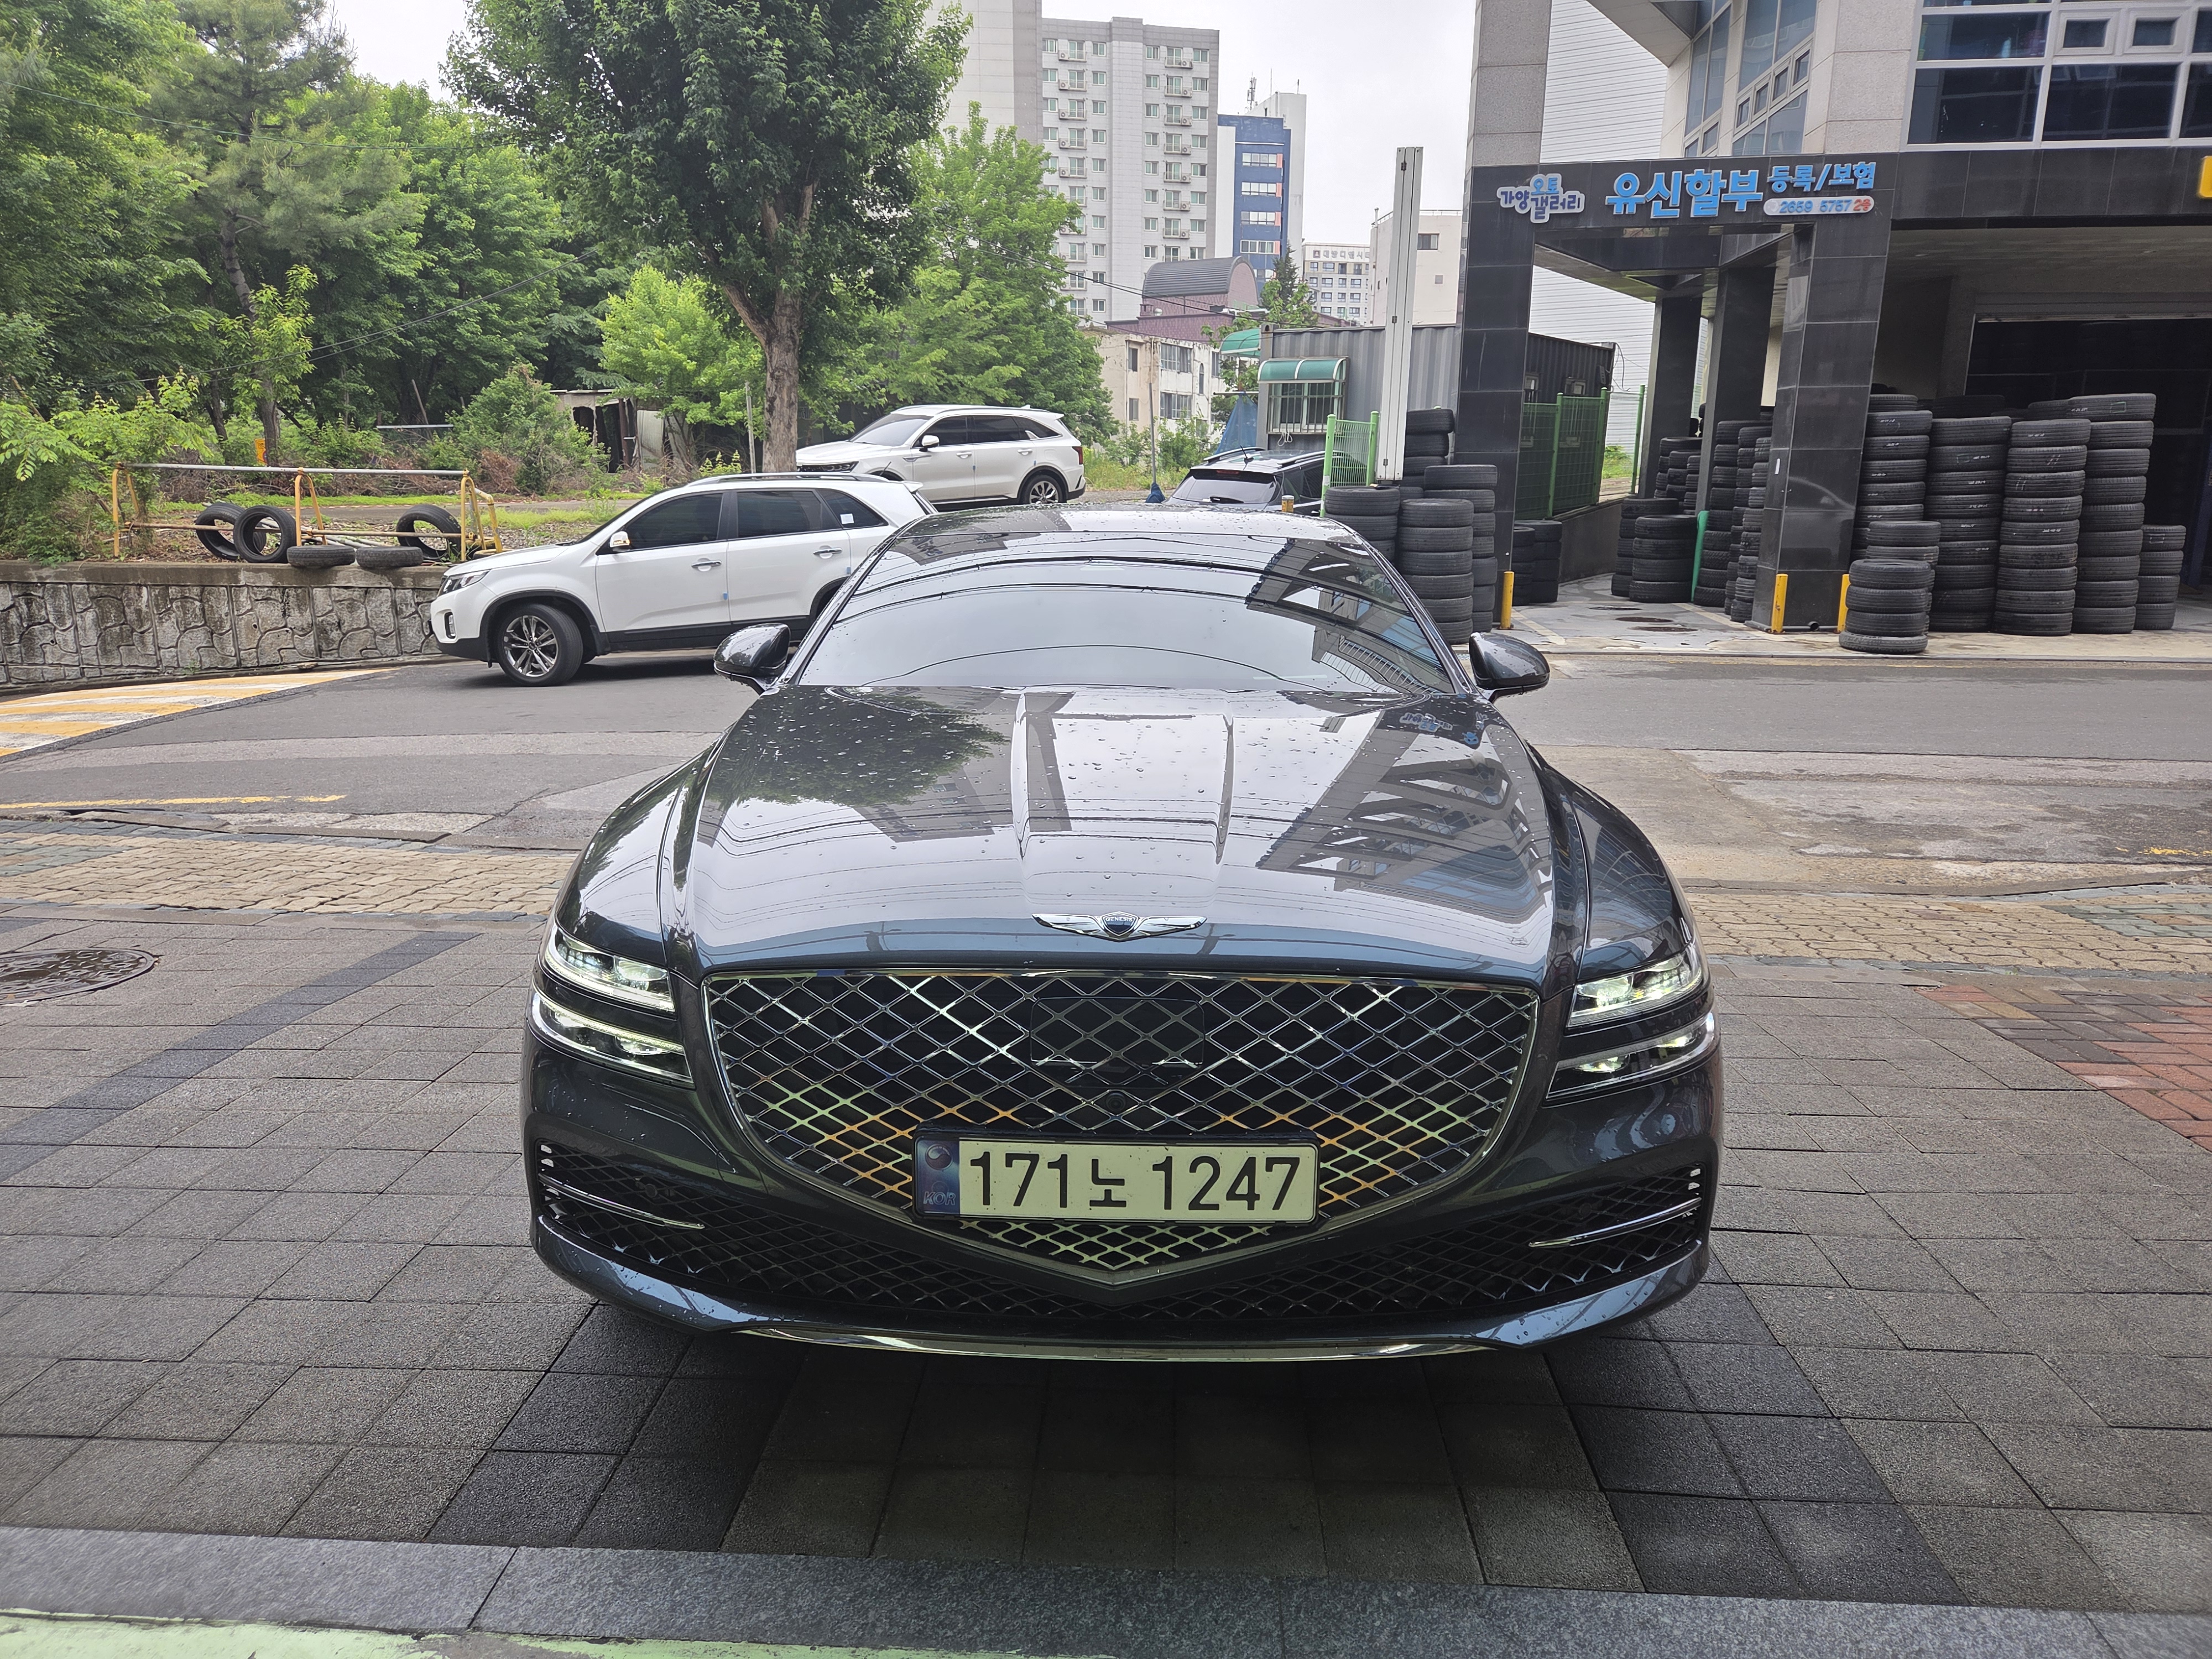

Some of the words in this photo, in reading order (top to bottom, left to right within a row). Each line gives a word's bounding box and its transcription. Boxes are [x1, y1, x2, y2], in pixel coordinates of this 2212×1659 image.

[1531, 178, 1559, 195] 오토
[1767, 161, 1876, 193] 등록/보험
[1500, 190, 1530, 210] 가양
[1605, 169, 1763, 218] 유신할부
[1531, 195, 1580, 220] 갤러리
[1780, 200, 1813, 213] 2659
[1819, 199, 1853, 212] 5757
[1853, 199, 1871, 211] 2층
[970, 1151, 1126, 1209] 171노
[1152, 1155, 1300, 1211] 1247
[923, 1191, 956, 1206] KOR
